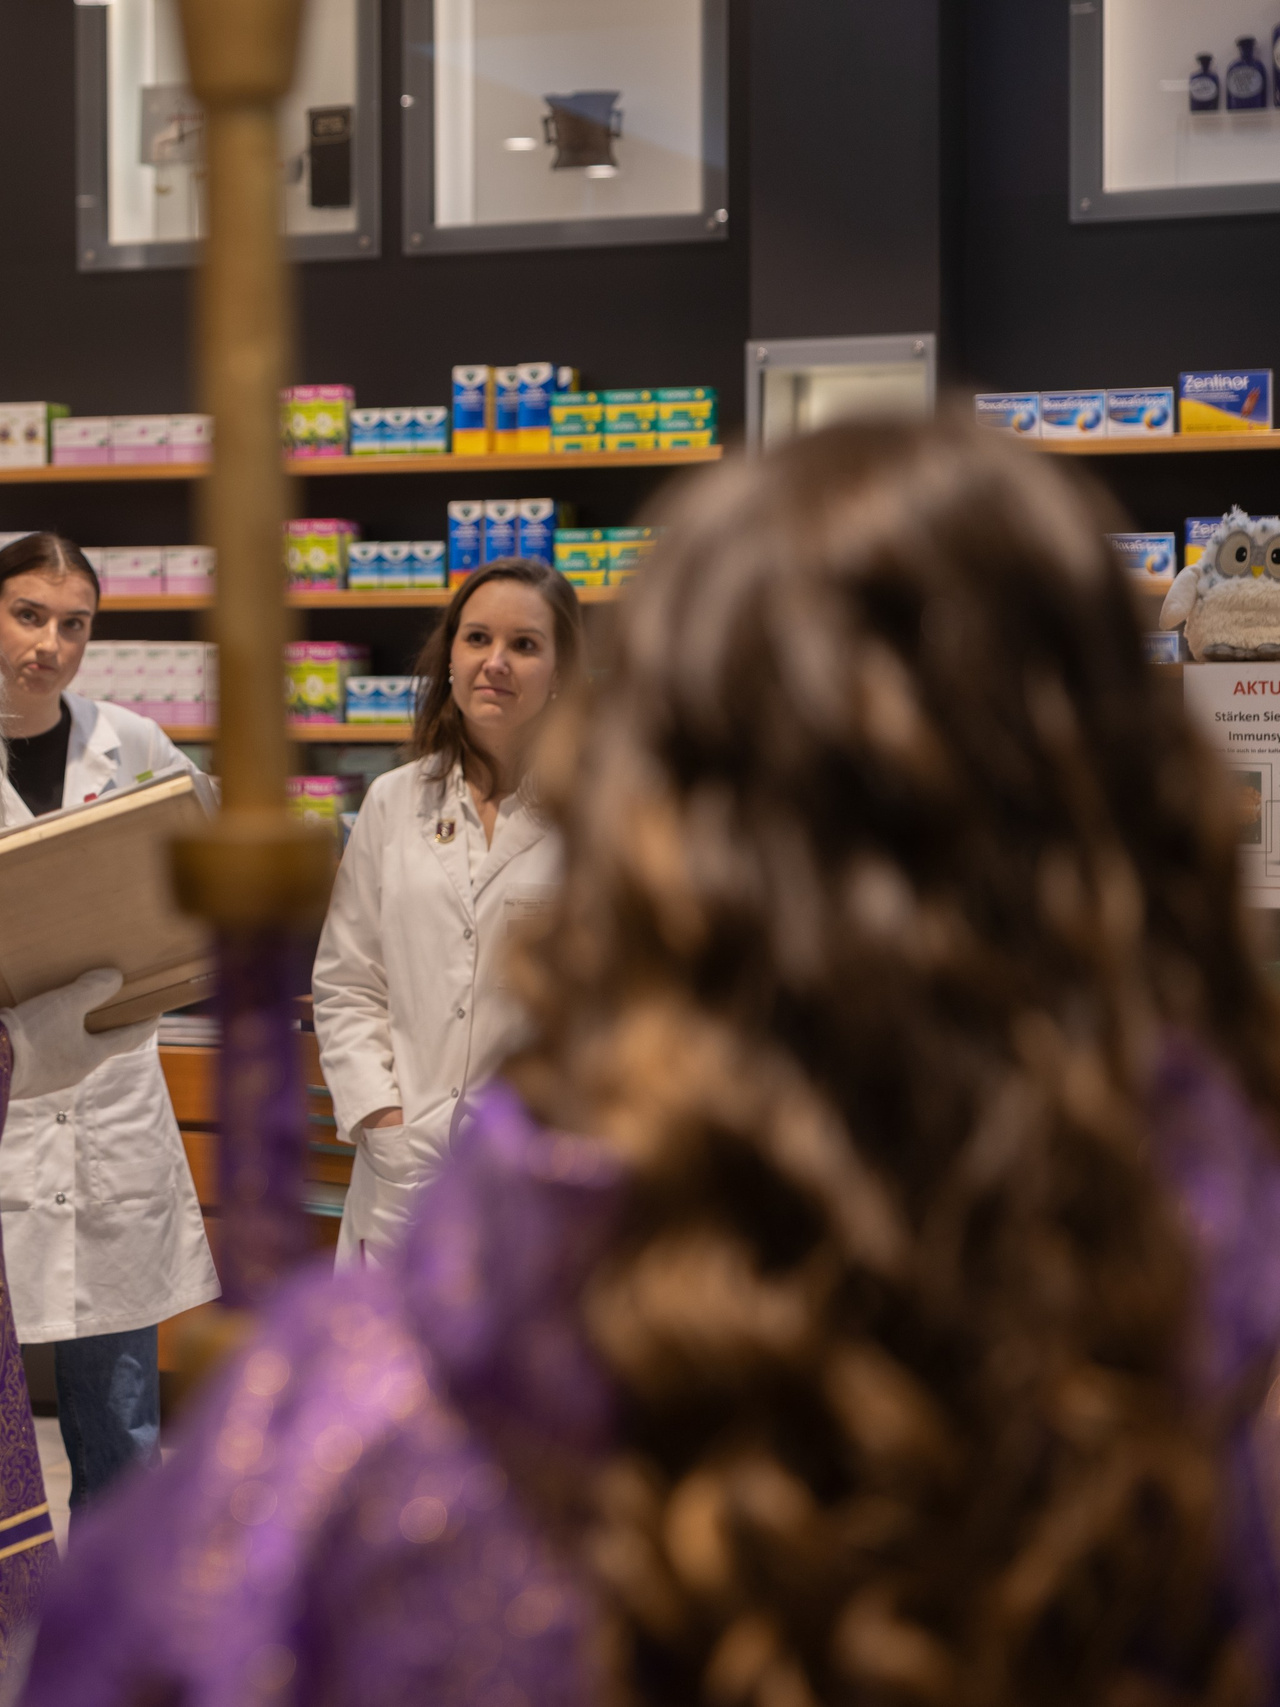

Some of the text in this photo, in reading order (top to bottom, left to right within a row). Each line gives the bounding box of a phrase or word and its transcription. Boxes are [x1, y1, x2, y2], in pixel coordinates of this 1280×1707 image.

[1185, 374, 1249, 391] Zentinor
[1233, 681, 1280, 696] AKTU
[1215, 711, 1280, 722] Stärken Sie
[1228, 731, 1280, 743] Immunsy
